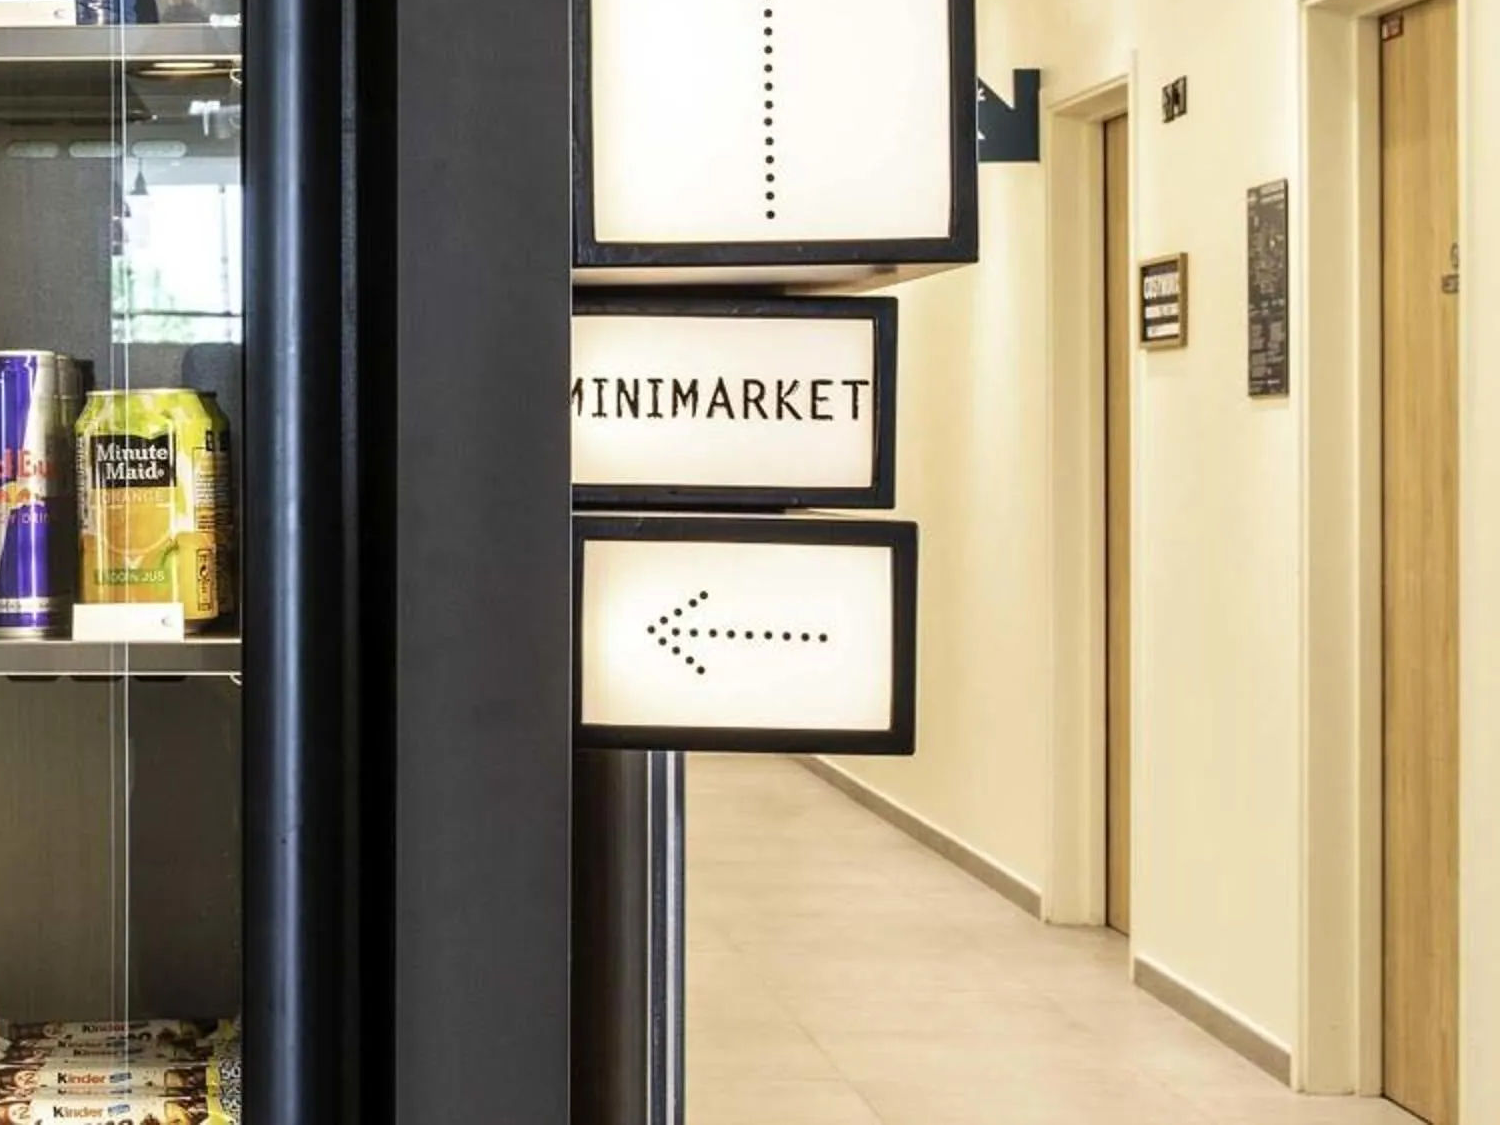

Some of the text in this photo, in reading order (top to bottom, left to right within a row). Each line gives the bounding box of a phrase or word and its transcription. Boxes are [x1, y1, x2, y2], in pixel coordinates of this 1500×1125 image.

[96, 442, 169, 462] Minute
[105, 461, 159, 480] Maid
[57, 1071, 107, 1084] Kinder
[53, 1106, 103, 1119] Kinder
